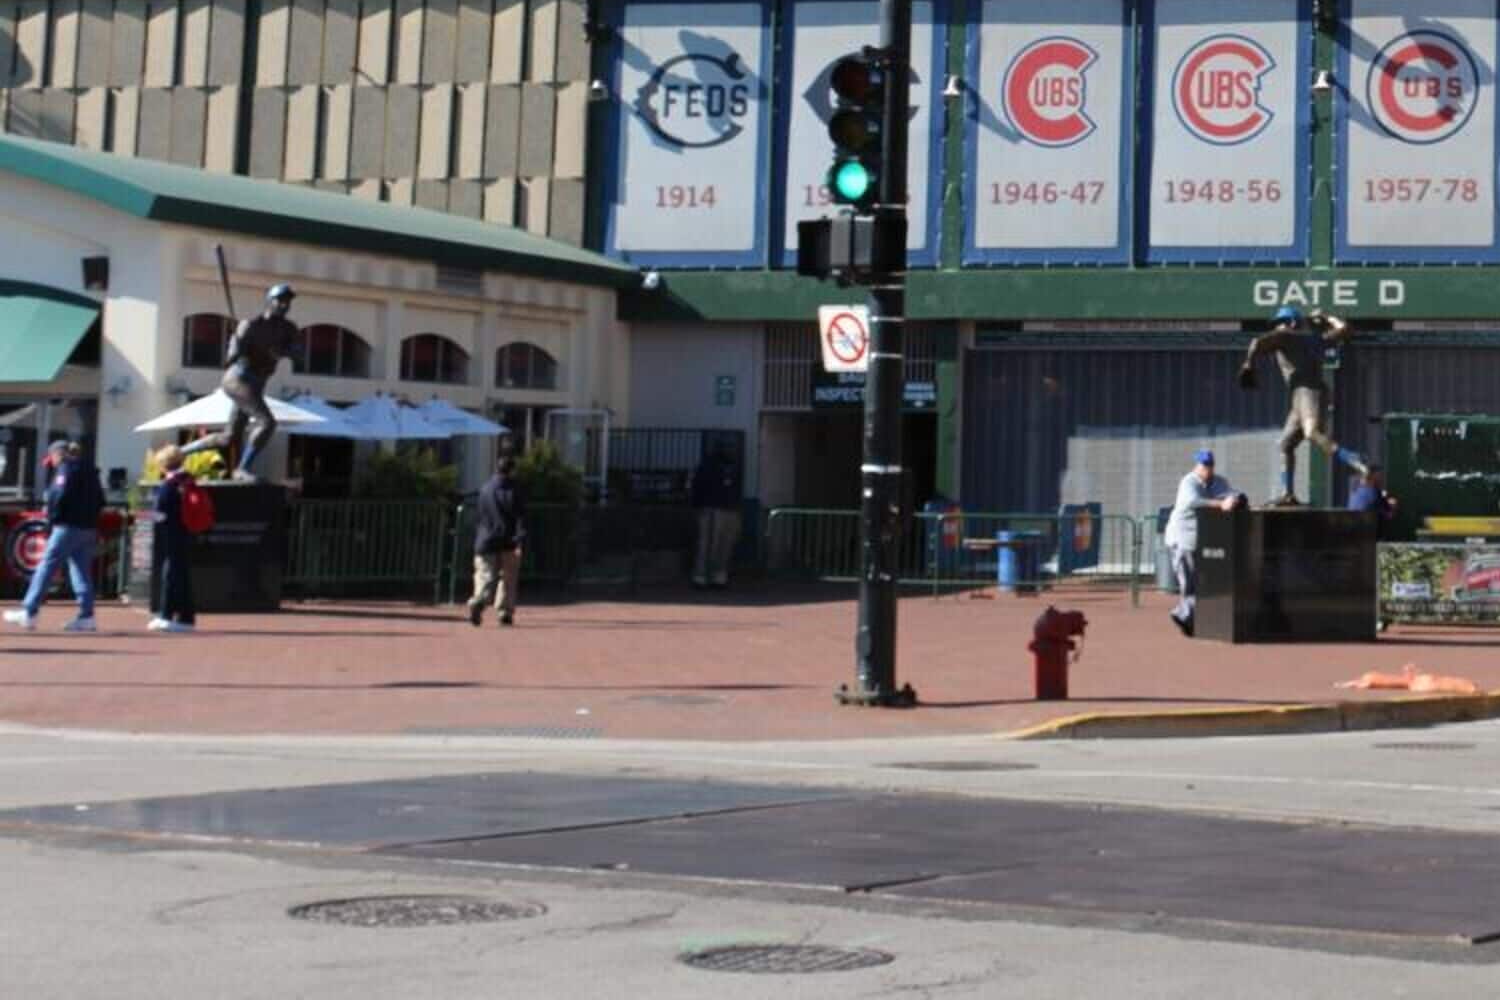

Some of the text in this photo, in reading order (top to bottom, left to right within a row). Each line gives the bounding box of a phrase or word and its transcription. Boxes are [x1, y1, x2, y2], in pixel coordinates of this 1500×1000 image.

[663, 85, 748, 118] FEDS
[655, 185, 716, 208] 1914
[990, 181, 1104, 205] 1946-47
[1165, 179, 1282, 203] 1948-56
[1364, 178, 1478, 202] 1957-78
[1253, 279, 1404, 306] GATE D
